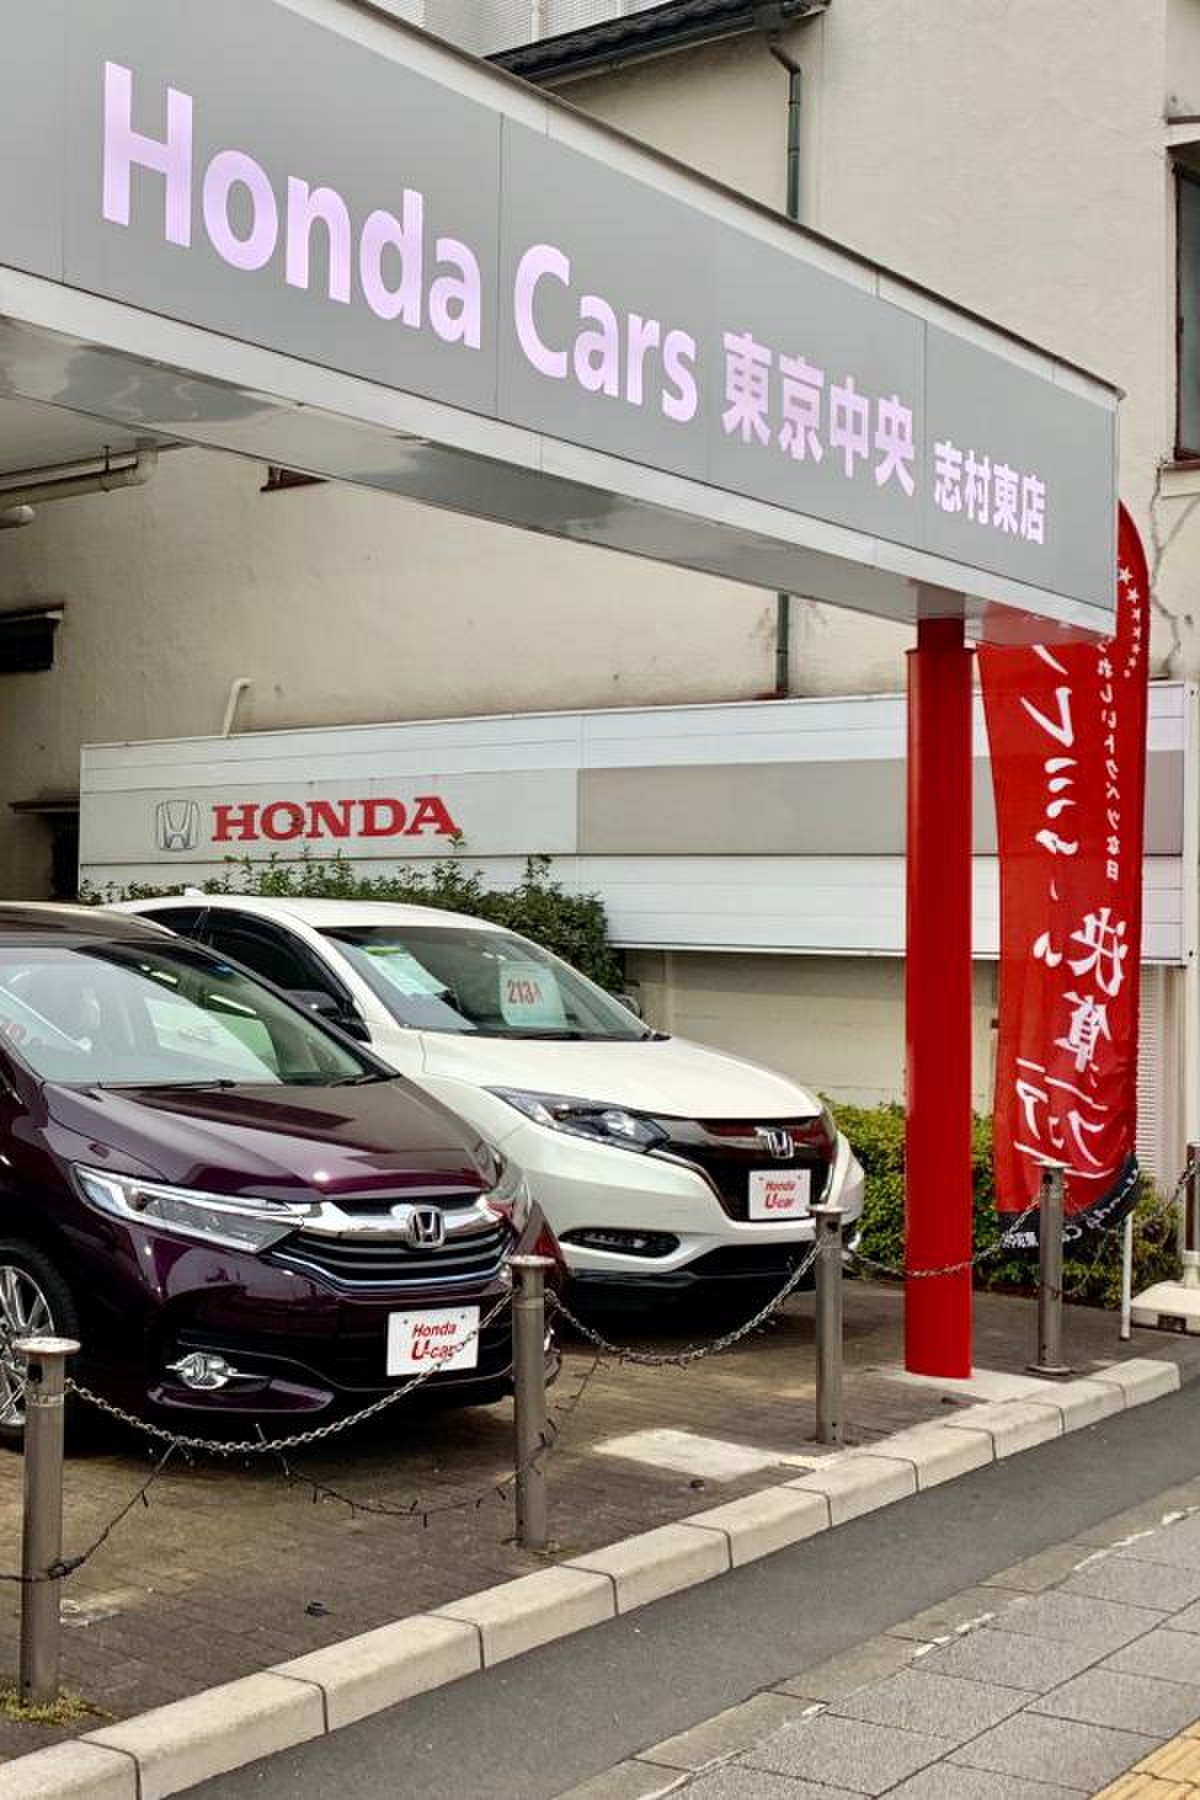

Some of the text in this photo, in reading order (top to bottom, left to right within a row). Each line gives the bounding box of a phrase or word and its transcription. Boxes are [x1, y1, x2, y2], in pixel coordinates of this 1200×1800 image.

[102, 60, 1046, 545] Honda Cars 東京中央 志村東店
[211, 796, 463, 842] HONDA
[411, 1320, 457, 1339] Honda
